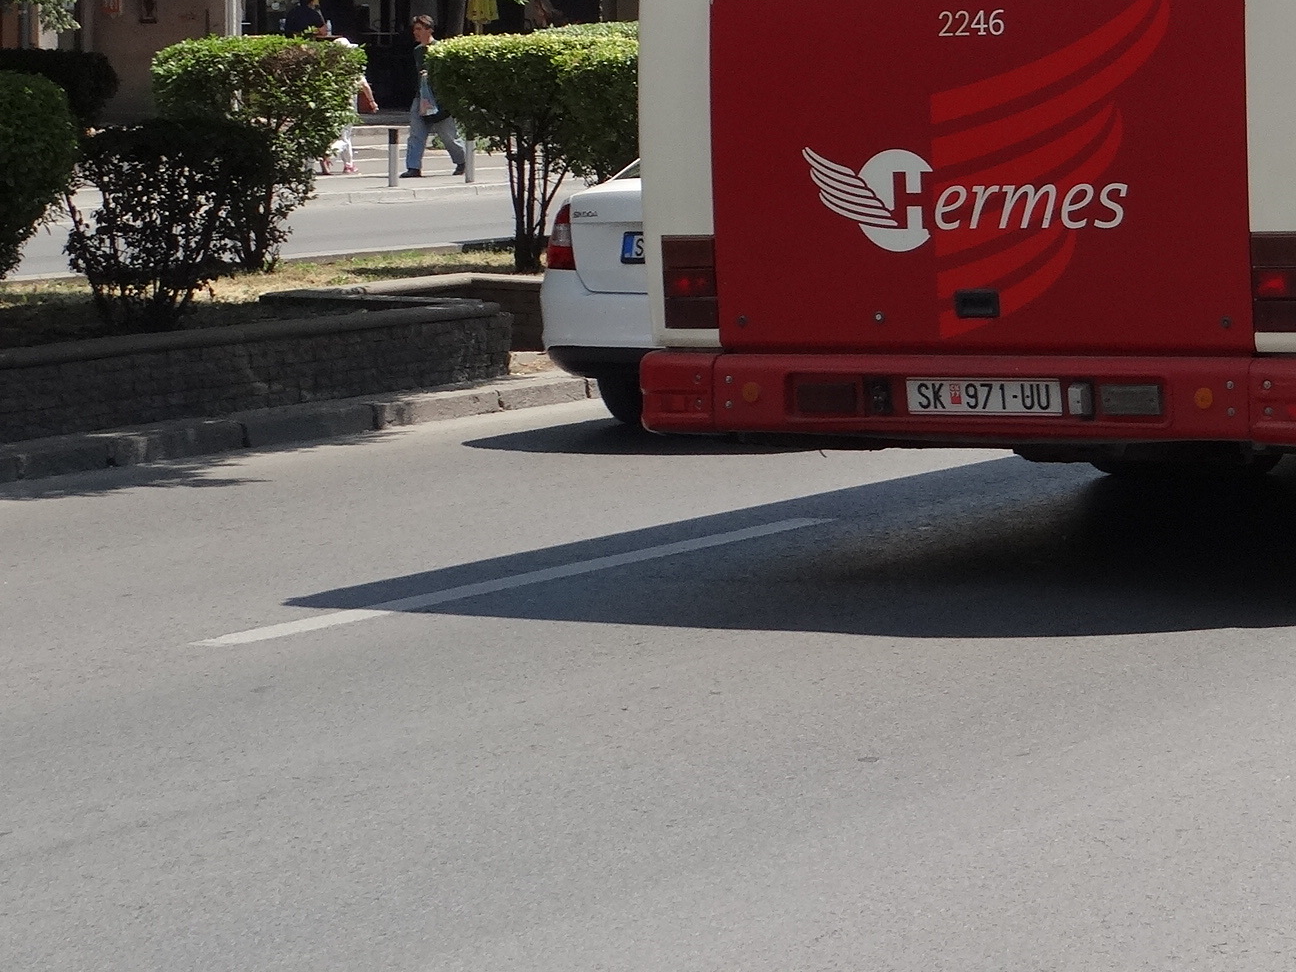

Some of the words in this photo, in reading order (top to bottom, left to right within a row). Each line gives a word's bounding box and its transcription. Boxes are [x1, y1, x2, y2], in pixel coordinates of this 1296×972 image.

[938, 9, 1006, 37] 2246
[848, 148, 1128, 252] Hermes
[917, 383, 946, 410] SK
[965, 383, 1051, 411] 971-UU
